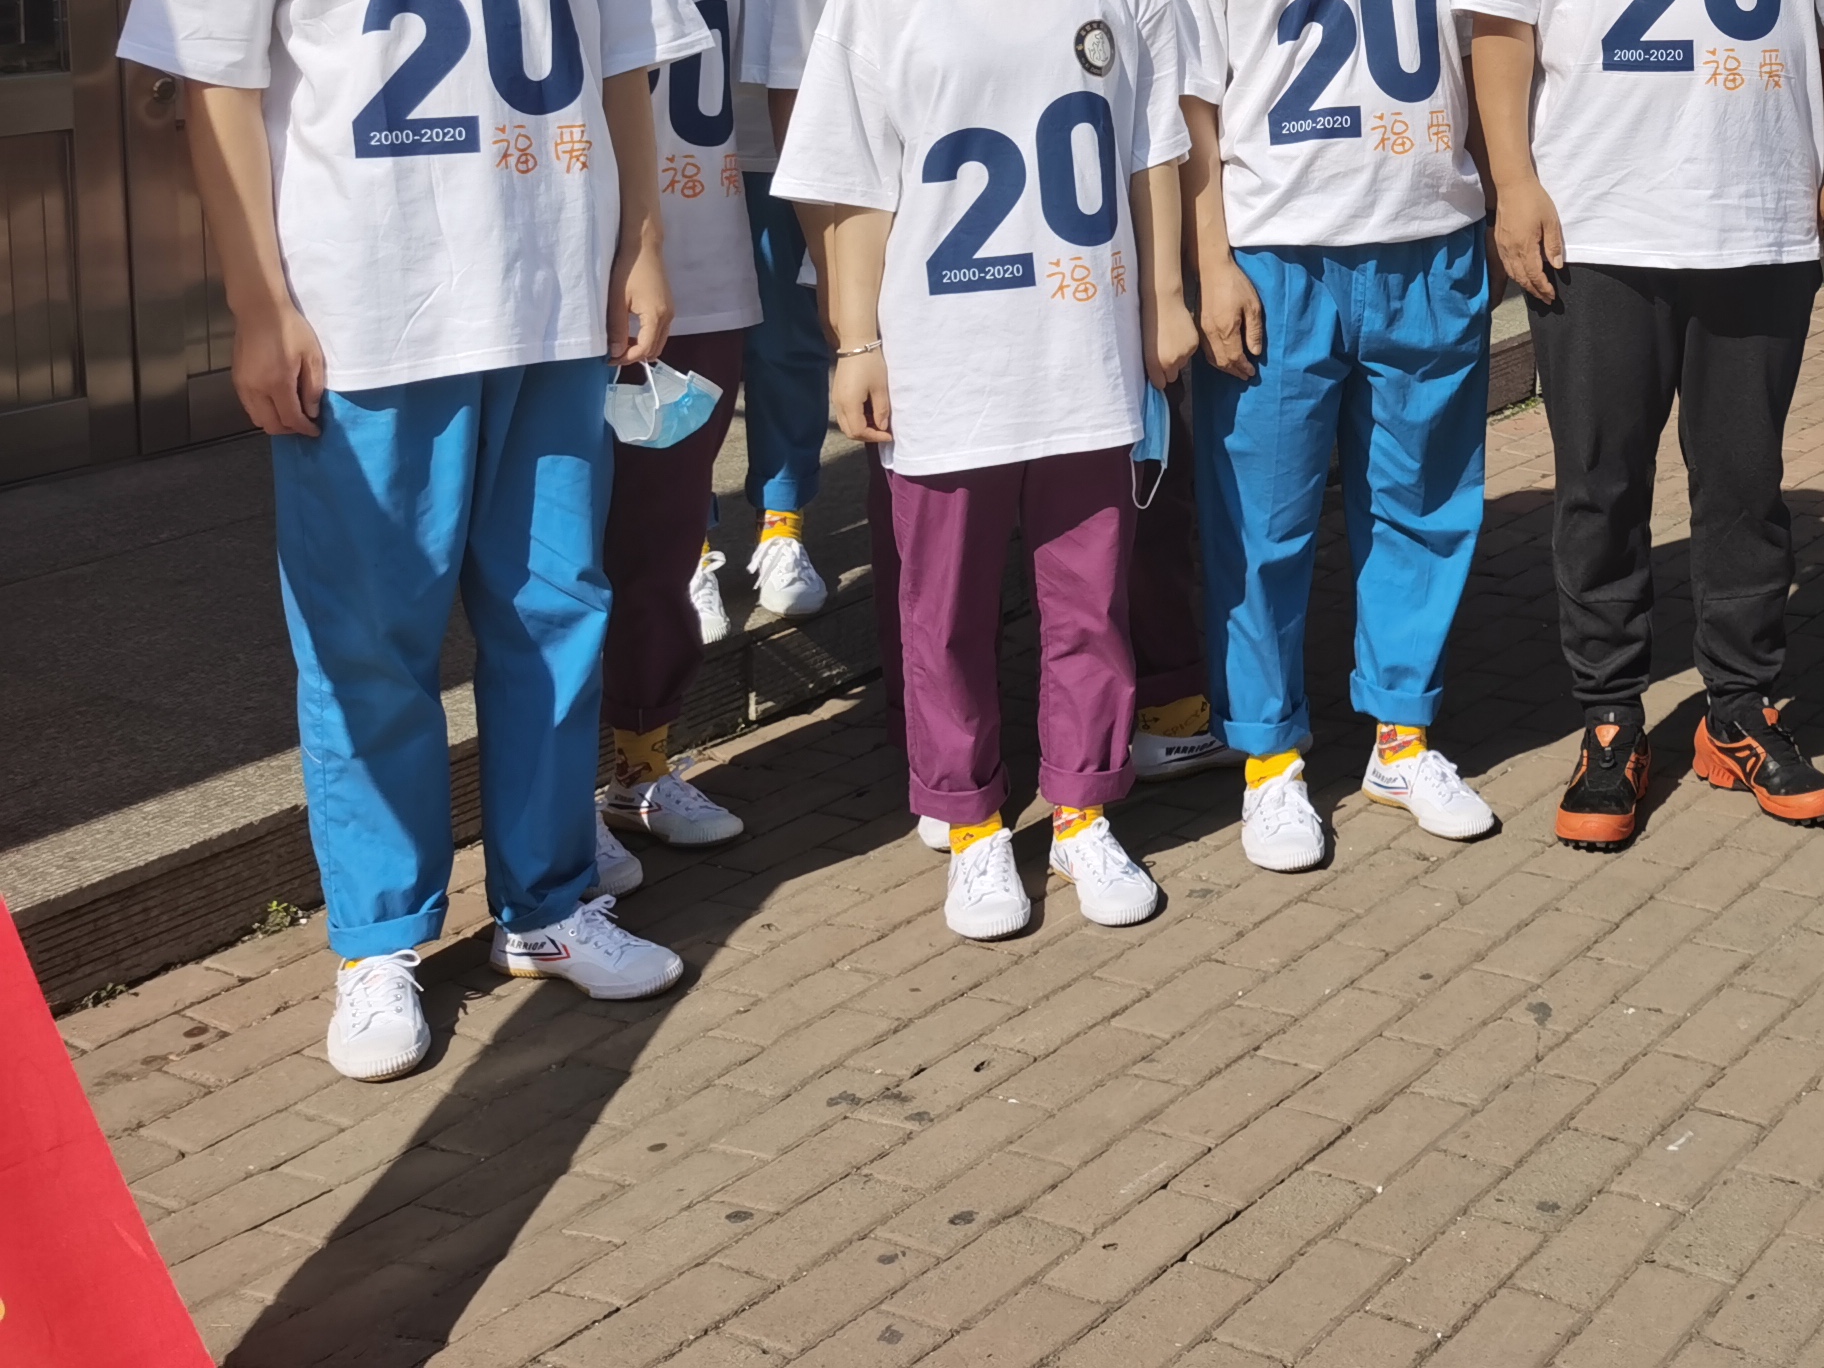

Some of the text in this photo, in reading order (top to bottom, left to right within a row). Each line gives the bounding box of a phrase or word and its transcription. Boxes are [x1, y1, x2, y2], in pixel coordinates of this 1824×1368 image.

[1613, 48, 1684, 62] 2000-2020
[1281, 115, 1351, 135] 2000-2020
[369, 127, 466, 146] 2000-2020
[921, 90, 1118, 296] 20
[942, 263, 1023, 283] 2000-2020
